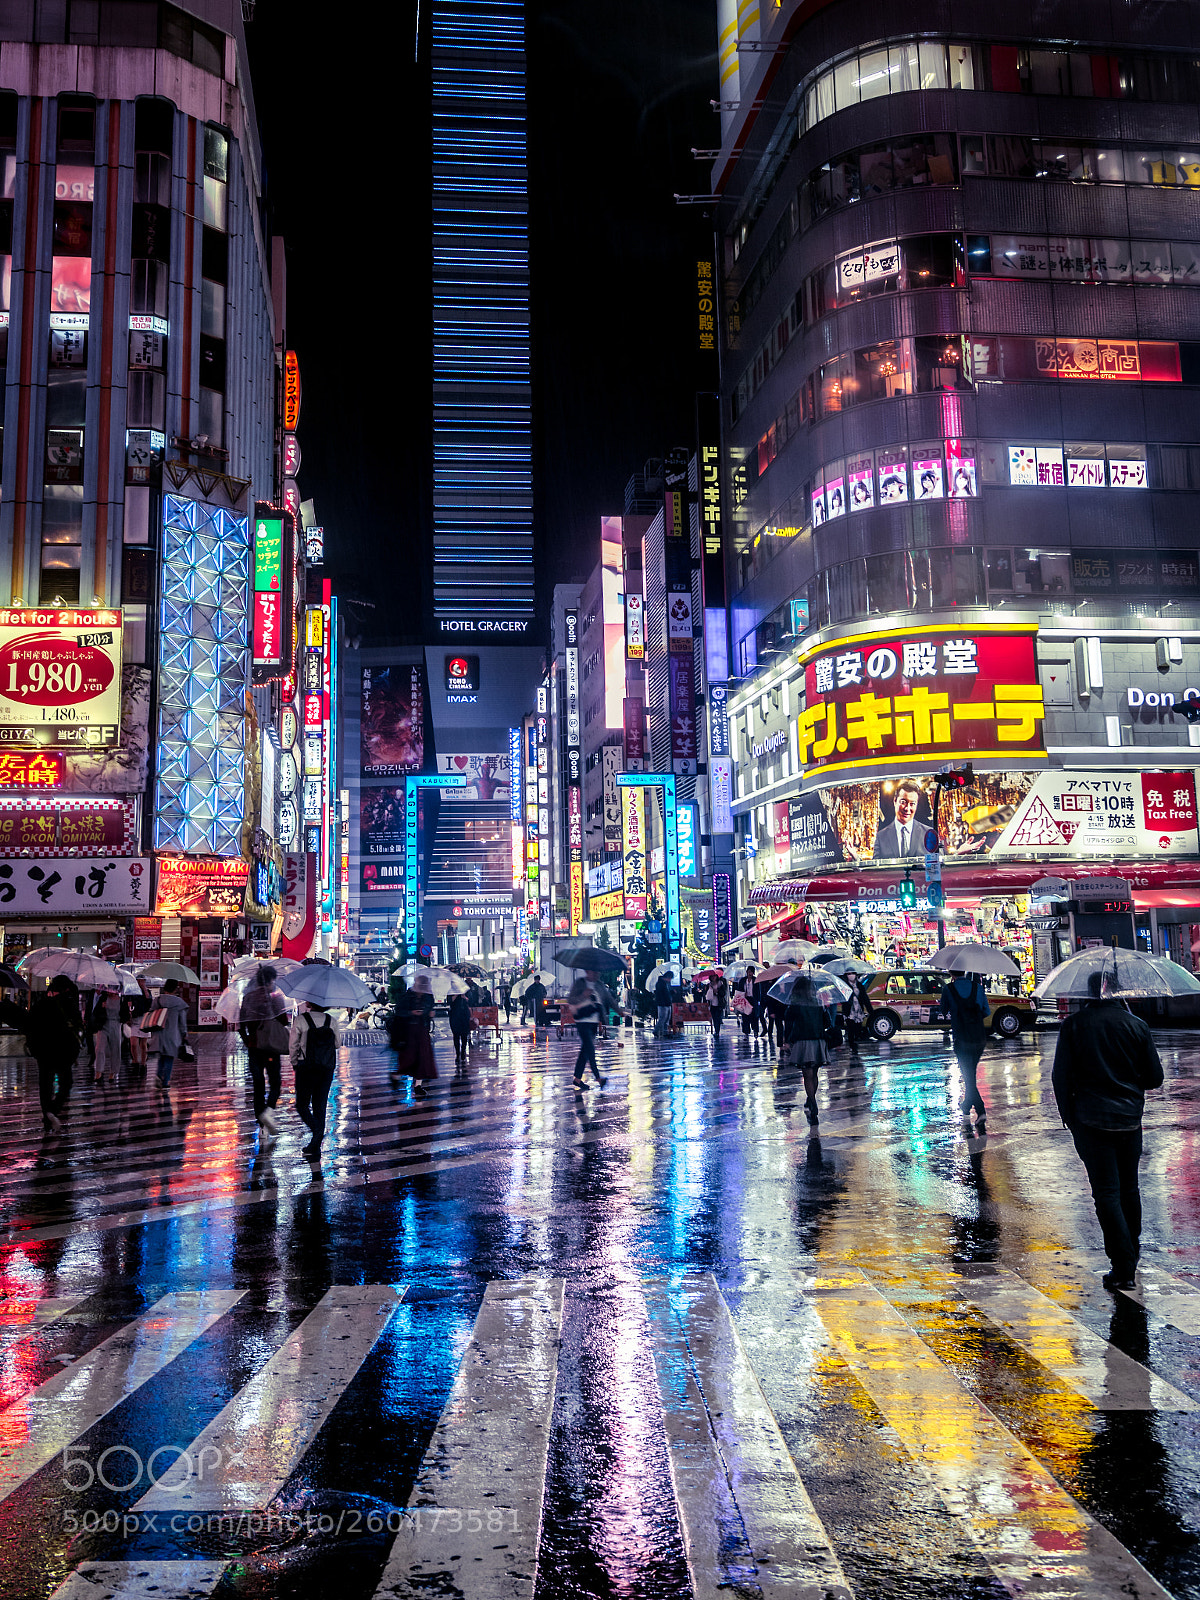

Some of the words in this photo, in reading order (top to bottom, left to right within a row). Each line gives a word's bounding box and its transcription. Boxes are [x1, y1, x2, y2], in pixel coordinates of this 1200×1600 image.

[1018, 243, 1066, 253] namco
[696, 261, 715, 351] 驚安の殿堂
[1038, 462, 1064, 485] 新宿
[1069, 463, 1104, 485] アイドル
[1111, 464, 1145, 486] ステージ
[1073, 558, 1111, 578] 販売
[1117, 563, 1154, 575] ブランド
[1161, 562, 1197, 576] 時計
[31, 612, 54, 625] for
[58, 612, 69, 625] 2
[73, 612, 118, 625] hours
[440, 621, 477, 631] HOTEL
[478, 621, 528, 631] GRACERY
[259, 600, 276, 658] ひょうたん
[565, 615, 578, 643] Booth
[631, 619, 640, 643] 鳥メロ
[80, 633, 111, 647] 120分
[814, 638, 980, 695] 驚安の殿堂
[5, 662, 83, 697] 1,980
[83, 682, 103, 693] yen
[362, 668, 372, 716] 起動する。
[447, 695, 477, 703] IMAX
[676, 670, 691, 712] 居楽屋
[1127, 687, 1175, 707] Don
[86, 726, 115, 743] 5F
[752, 740, 764, 759] Don
[364, 763, 421, 772] GODZILLA
[445, 756, 454, 771] I
[568, 750, 580, 779] Booth
[1066, 780, 1132, 792] アベマTVで
[1094, 796, 1102, 811] よる
[1101, 796, 1135, 811] 10時
[1107, 813, 1136, 829] 放送
[1147, 809, 1168, 819] Tax
[1169, 809, 1193, 819] Free
[20, 815, 105, 832] お好み焼き
[1059, 822, 1078, 835] GP
[407, 801, 416, 882] GODZILLA
[608, 842, 621, 851] B1
[677, 807, 694, 874] カラオケ
[161, 860, 219, 872] OKONOMI
[222, 862, 249, 874] YAKI
[667, 809, 677, 916] ゴジラロード
[624, 849, 646, 895] 金の蔵
[857, 886, 883, 897] Don
[407, 890, 416, 929] ROAD
[463, 907, 486, 916] TOHO
[626, 898, 641, 911] 2F
[717, 877, 729, 931] カラオケ
[1104, 902, 1130, 912] エリア
[698, 909, 711, 953] カラオケ
[718, 932, 729, 941] B1
